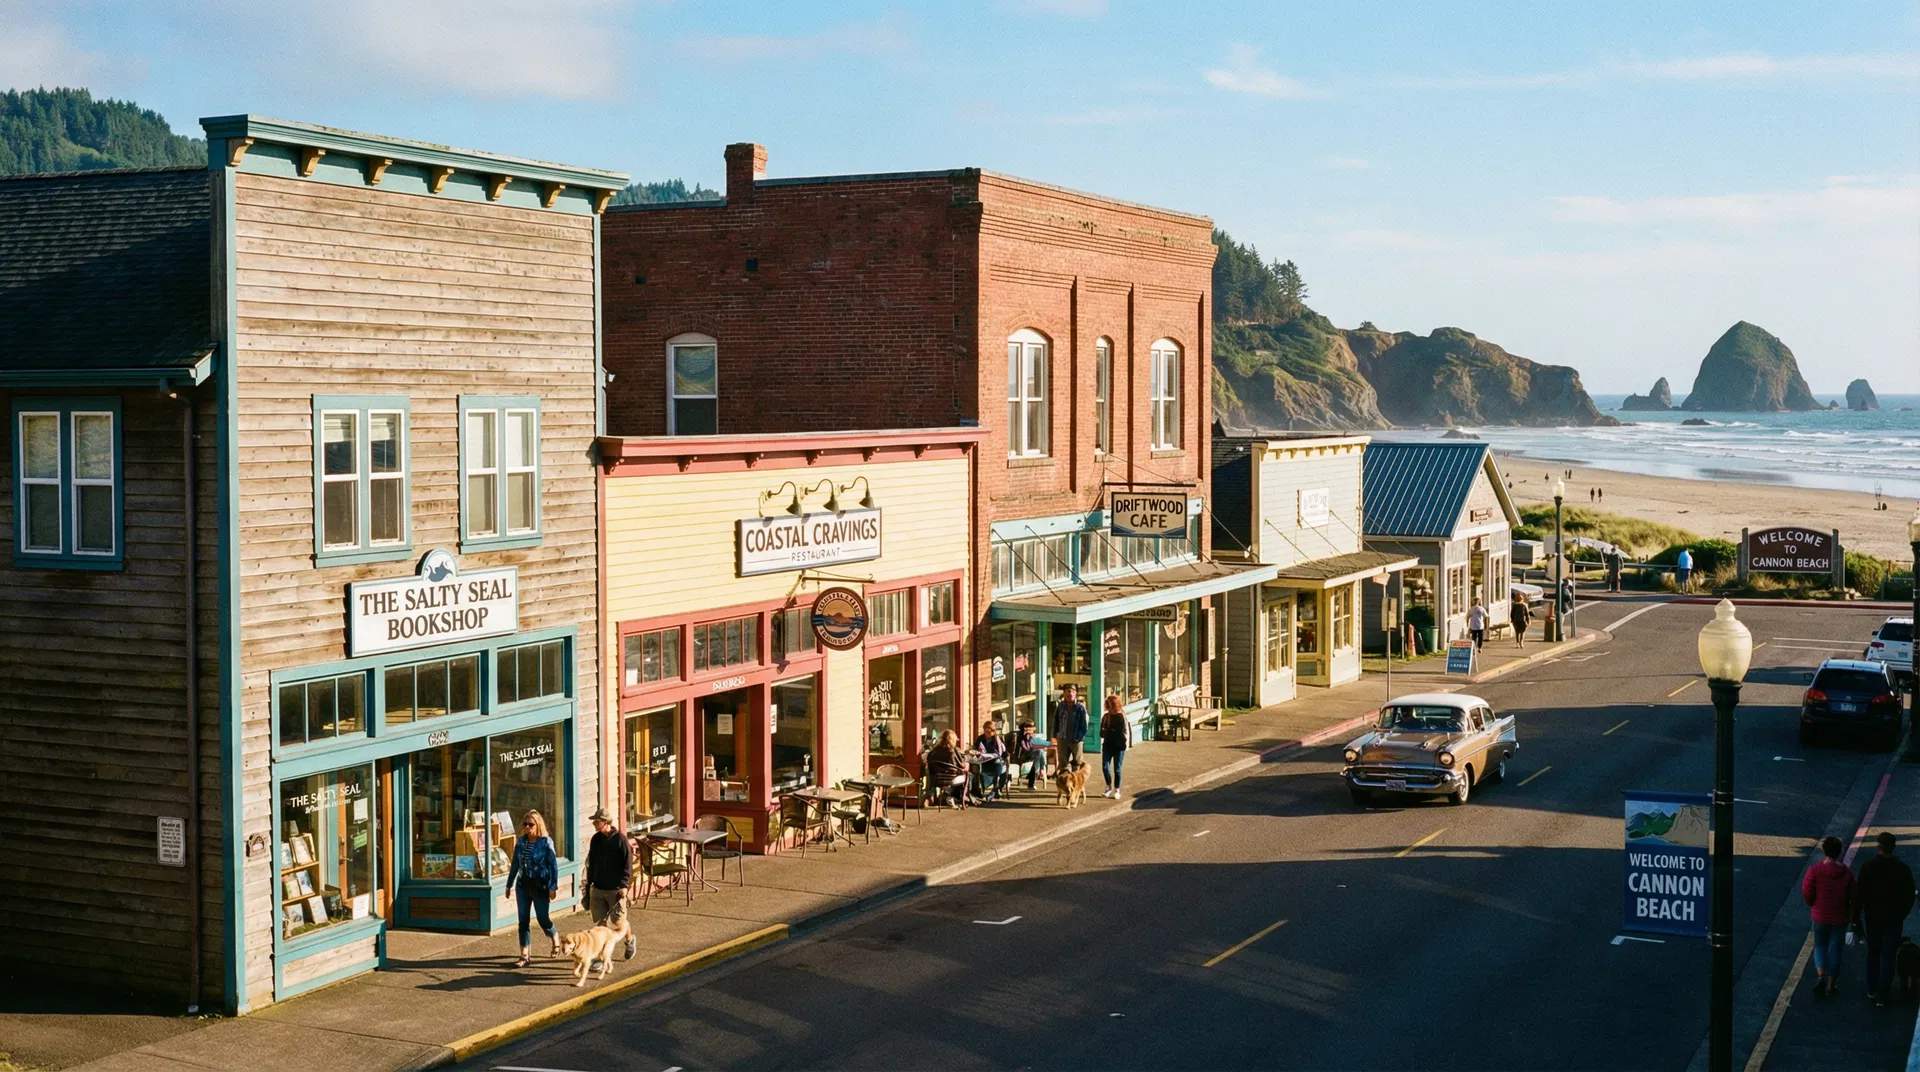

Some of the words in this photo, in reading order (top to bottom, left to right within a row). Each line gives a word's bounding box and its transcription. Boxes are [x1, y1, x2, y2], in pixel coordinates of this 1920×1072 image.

[1115, 498, 1183, 515] DRIFTWOOD
[1130, 514, 1168, 528] CAFE
[745, 525, 809, 553] COASTAL
[813, 517, 878, 546] CRAVINGS
[1758, 530, 1824, 548] WELCOME
[791, 547, 841, 562] RESTAURANT
[1784, 544, 1797, 554] TO
[1752, 557, 1793, 568] CANNON
[1796, 558, 1829, 568] BEACH
[359, 590, 399, 616] THE
[405, 583, 463, 611] SALTY
[468, 578, 513, 603] SEAL
[387, 606, 489, 641] BOOKSHOP
[499, 751, 514, 763] THE
[514, 746, 537, 760] SALTY
[536, 742, 554, 754] SEAL
[290, 794, 310, 808] THE
[339, 783, 362, 796] SEAL
[1629, 852, 1687, 870] WELCOME
[1689, 856, 1705, 871] TO
[1628, 872, 1705, 897] CANNON
[1636, 897, 1695, 921] BEACH
